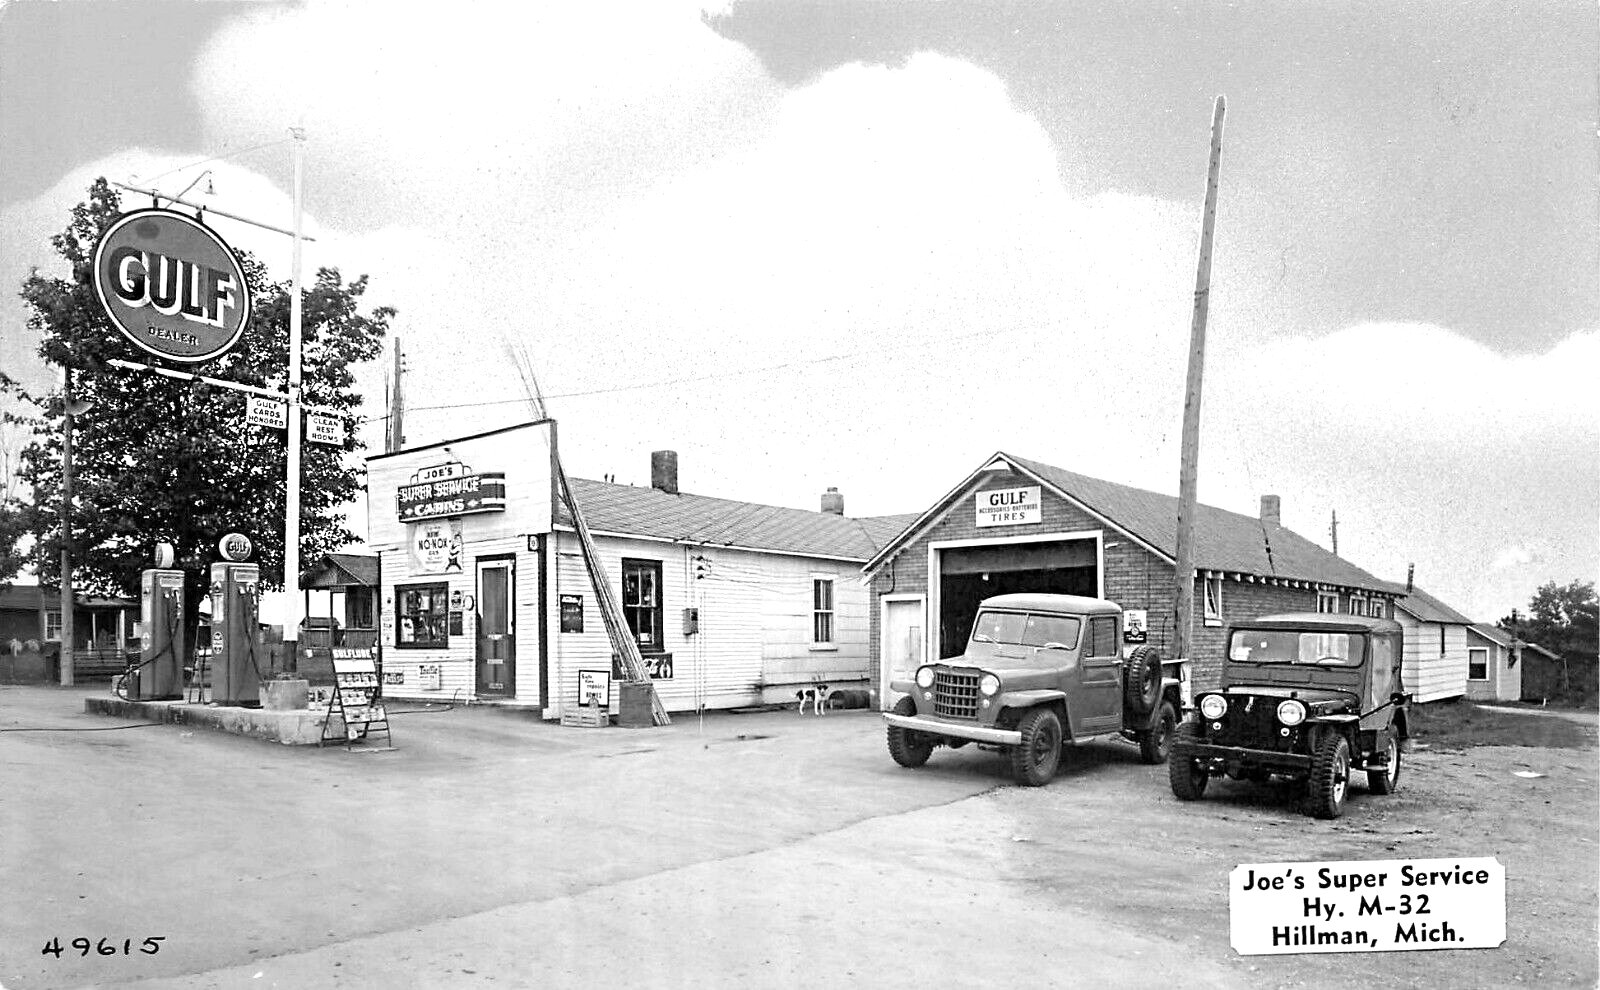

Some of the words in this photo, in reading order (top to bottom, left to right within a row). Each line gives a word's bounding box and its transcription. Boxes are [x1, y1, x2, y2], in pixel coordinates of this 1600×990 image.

[108, 246, 238, 328] GULF
[148, 326, 200, 346] DEALER
[256, 400, 278, 410] GULF
[253, 408, 281, 419] CARDS
[248, 415, 284, 427] HONORED
[313, 418, 339, 427] CLEAN
[311, 433, 338, 443] ROOMS
[424, 467, 453, 480] JOE'S
[400, 484, 433, 503] SUPER
[433, 476, 480, 497] SERVICE
[989, 491, 1028, 506] GULF
[414, 499, 465, 516] CABINS
[991, 511, 1026, 522] TIRES
[228, 541, 249, 554] GULF
[418, 537, 448, 550] NO-NOX
